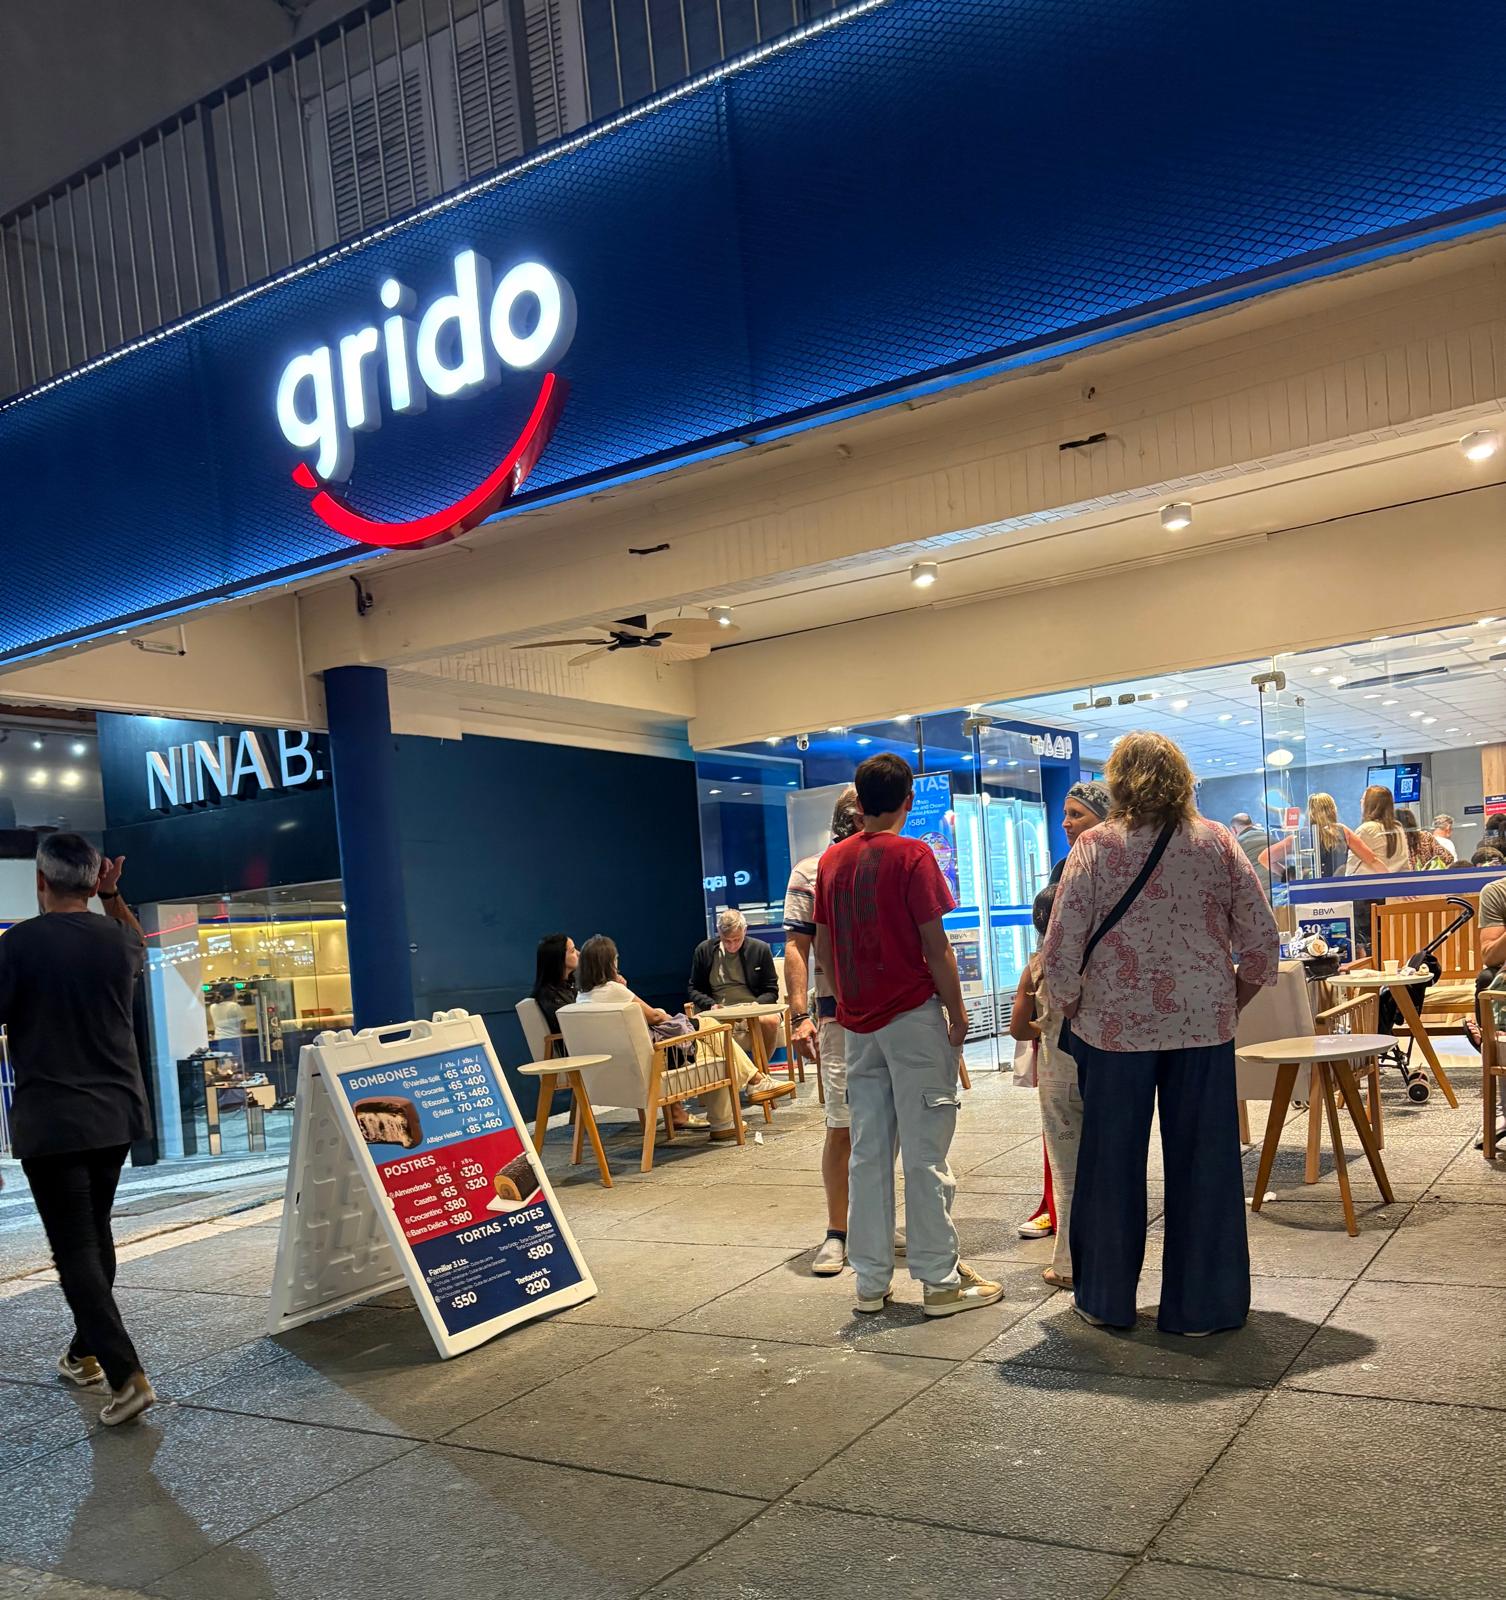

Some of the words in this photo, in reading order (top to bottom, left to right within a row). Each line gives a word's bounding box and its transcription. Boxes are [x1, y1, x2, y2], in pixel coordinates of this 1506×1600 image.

[276, 249, 562, 480] grido
[146, 730, 278, 810] NINA
[278, 729, 324, 788] B.
[1313, 908, 1335, 916] BBVA
[349, 1066, 418, 1090] BOMBONES
[444, 1068, 459, 1079] $65
[460, 1064, 481, 1075] $400
[421, 1086, 445, 1096] Crocante
[448, 1080, 463, 1090] $65
[464, 1075, 486, 1086] $400
[452, 1092, 467, 1102] $75
[468, 1086, 490, 1097] $460
[438, 1108, 454, 1116] Suizo
[458, 1102, 472, 1113] $70
[472, 1097, 494, 1108] $420
[426, 1136, 444, 1144] Alfajor
[444, 1130, 462, 1139] Helado
[466, 1124, 482, 1134] $85
[482, 1118, 502, 1129] $460
[384, 1155, 436, 1178] POSTRES
[394, 1182, 432, 1198] Almendrado
[435, 1173, 452, 1184] $65
[460, 1163, 482, 1177] $320
[414, 1195, 438, 1206] Casatta
[440, 1186, 458, 1198] $65
[466, 1176, 488, 1190] $320
[409, 1208, 443, 1222] Crocantino
[444, 1198, 466, 1212] $380
[410, 1226, 428, 1236] Barra
[427, 1220, 448, 1232] Delicia
[450, 1210, 472, 1225] $380
[456, 1222, 502, 1245] TORTAS
[508, 1207, 544, 1227] POTES
[534, 1222, 552, 1232] Tortas
[528, 1242, 554, 1260] $580
[428, 1263, 452, 1276] Familiar
[515, 1269, 544, 1284] Tentación
[526, 1278, 550, 1294] $290
[452, 1292, 478, 1308] $550
